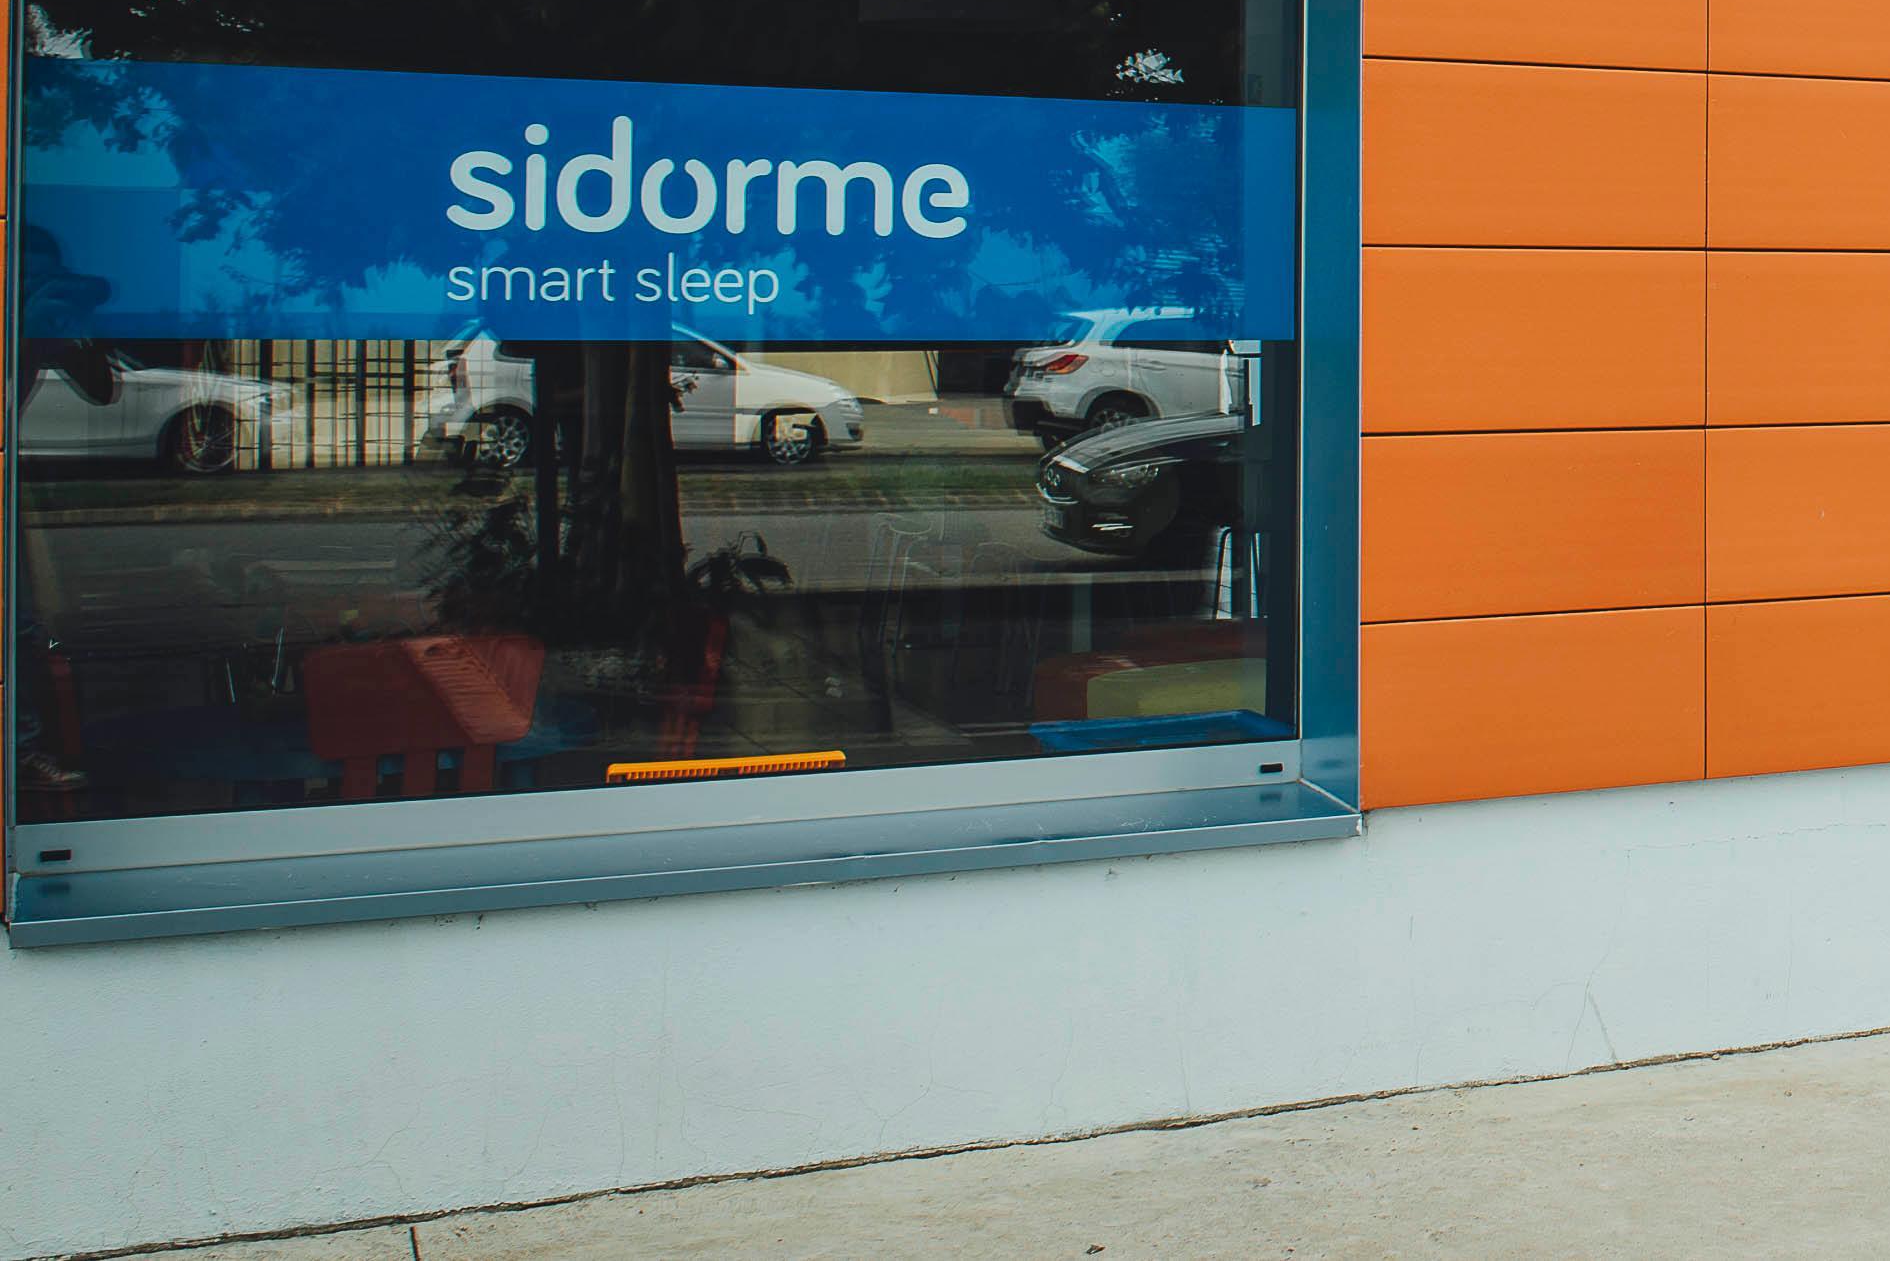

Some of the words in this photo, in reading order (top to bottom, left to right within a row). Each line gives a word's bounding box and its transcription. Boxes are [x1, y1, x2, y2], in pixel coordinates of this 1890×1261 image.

[445, 115, 970, 239] sidorme
[445, 258, 616, 303] smart
[635, 252, 780, 315] sleep
